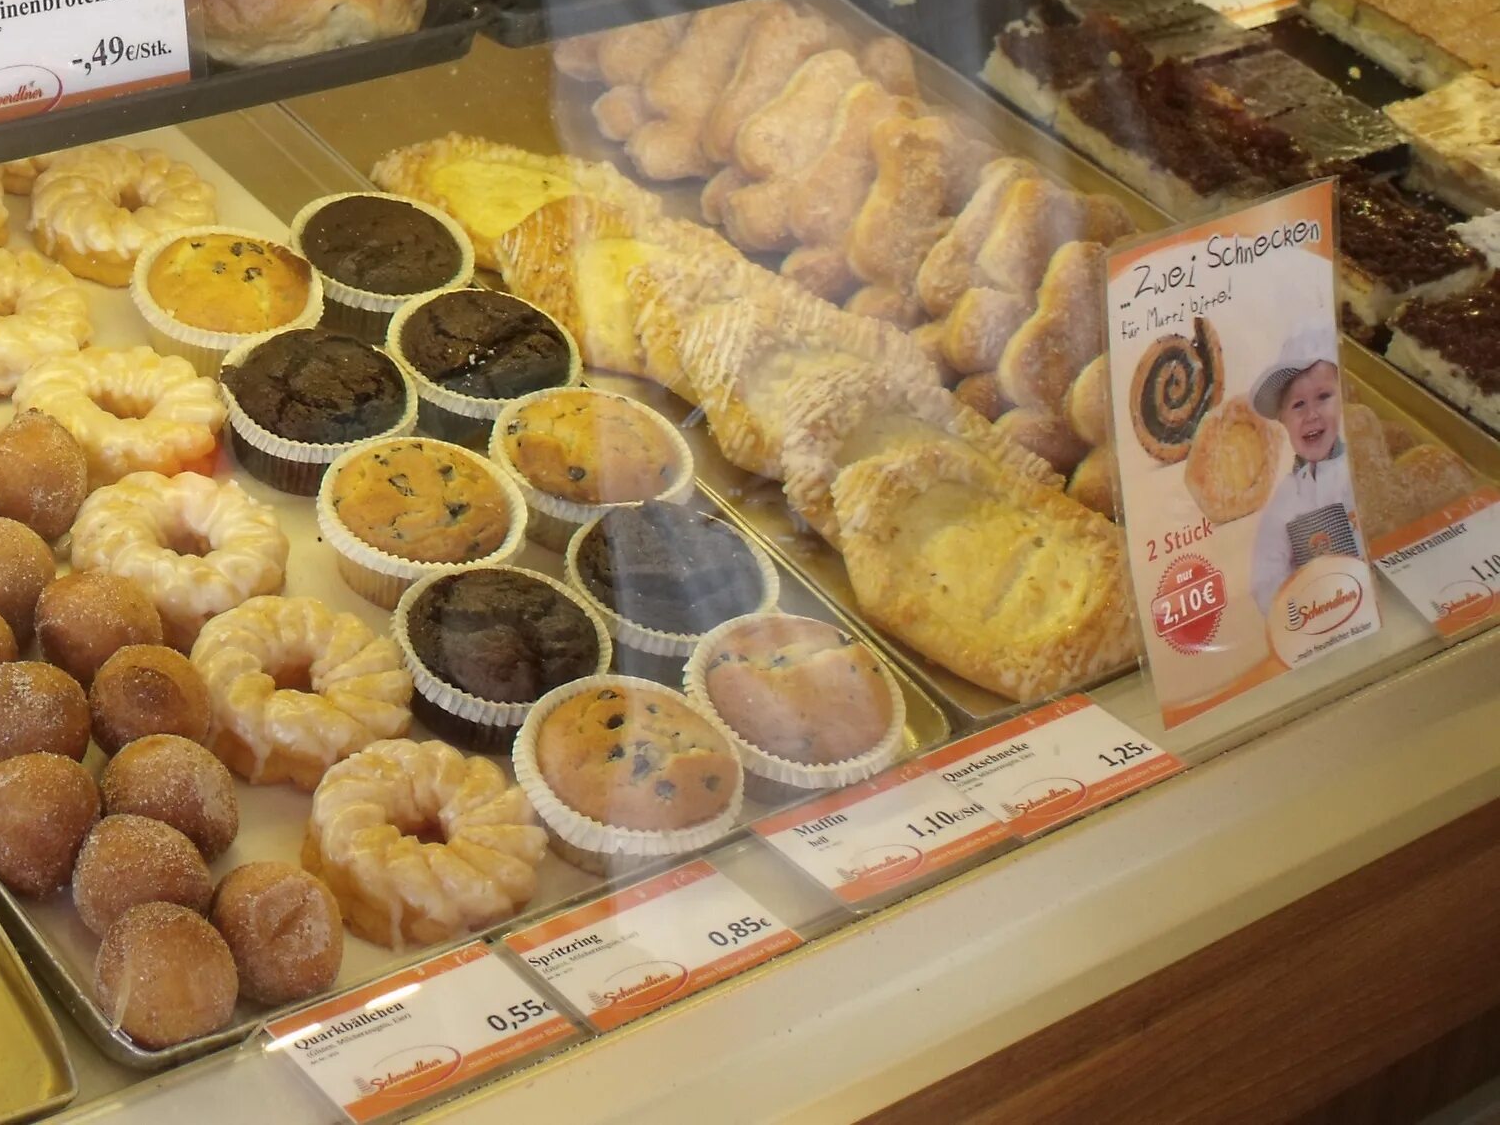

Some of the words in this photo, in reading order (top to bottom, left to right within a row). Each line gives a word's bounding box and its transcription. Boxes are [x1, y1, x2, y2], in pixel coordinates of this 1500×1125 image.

[71, 36, 173, 76] -,49€/Stk.
[1133, 255, 1197, 299] Zwei
[1206, 221, 1321, 269] Schnecken
[1146, 539, 1158, 563] 2
[1164, 517, 1214, 556] Stück
[1176, 568, 1194, 585] nur
[1160, 580, 1218, 626] 2,10€
[941, 742, 1031, 783] Quarkschnecke
[1098, 740, 1154, 768] 1,25€
[791, 813, 849, 838] Muffin
[528, 932, 604, 969] Spritzring
[707, 916, 773, 949] 0,85€
[293, 1000, 405, 1051] Quarkbällchen
